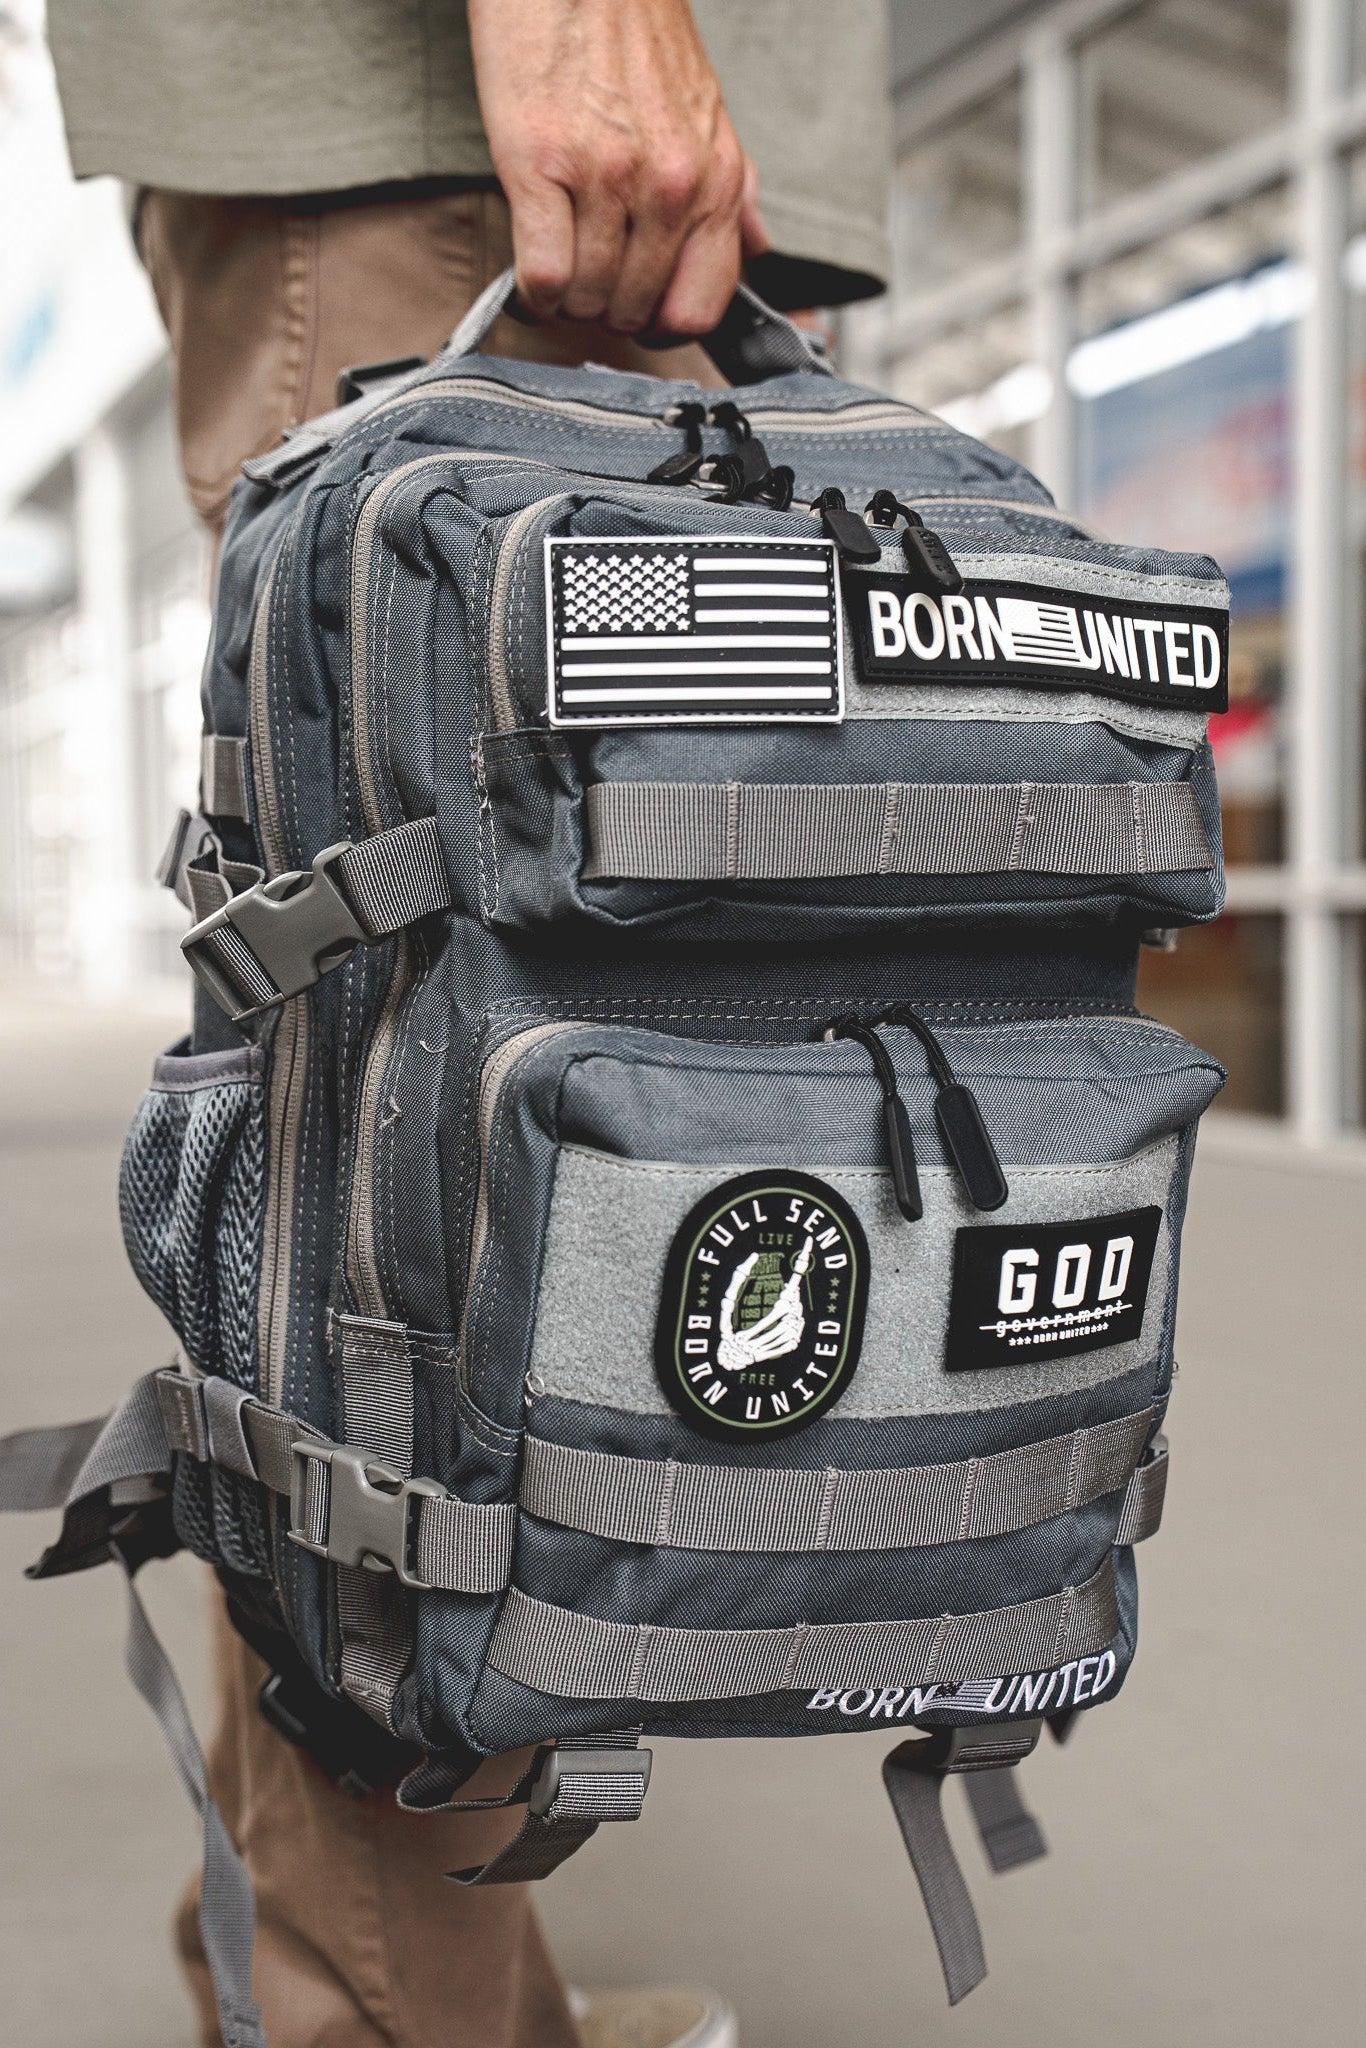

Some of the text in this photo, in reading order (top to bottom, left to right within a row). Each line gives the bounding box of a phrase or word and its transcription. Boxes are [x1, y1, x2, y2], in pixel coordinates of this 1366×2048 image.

[868, 590, 1221, 690] BORN UNITED
[698, 1198, 848, 1269] FULL SEND
[758, 1232, 794, 1245] LIVE
[998, 1235, 1134, 1314] GOD
[996, 1299, 1123, 1338] government
[685, 1314, 841, 1420] BORN UNITED
[739, 1373, 776, 1386] FREE
[806, 1650, 1116, 1718] BORN UNITED
